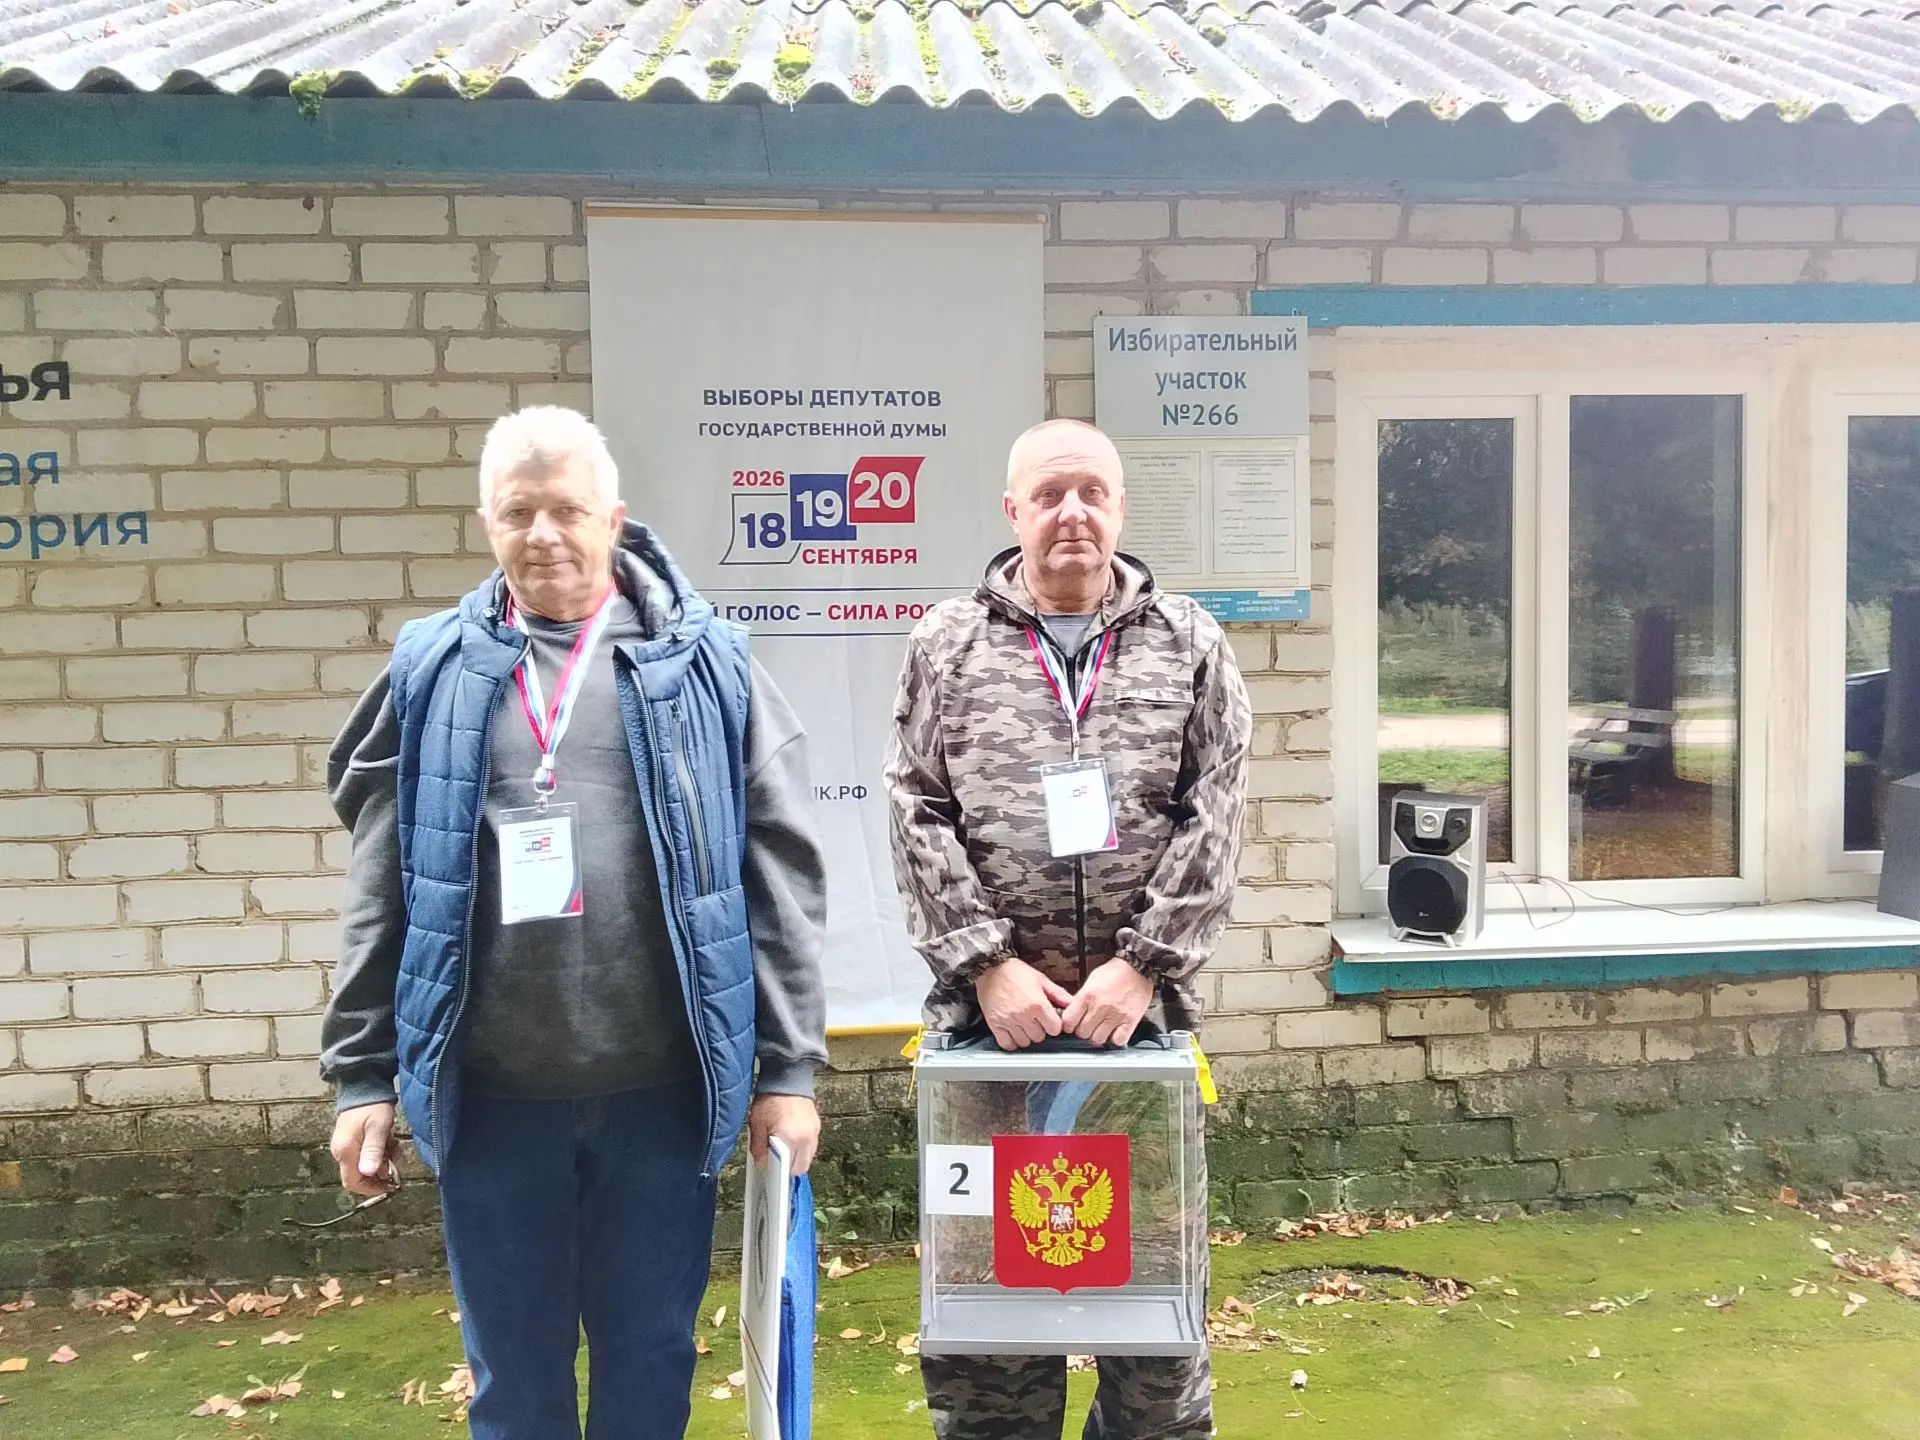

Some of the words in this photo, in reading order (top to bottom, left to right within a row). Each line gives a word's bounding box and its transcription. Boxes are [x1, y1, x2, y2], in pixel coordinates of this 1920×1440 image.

[1108, 328, 1298, 357] Избирательный
[1155, 371, 1247, 396] участок
[703, 389, 803, 406] ВЫБОРЫ
[809, 390, 942, 408] ДЕПУТАТОВ
[1162, 404, 1239, 426] №266
[699, 420, 885, 438] ГОСУДАРСТВЕННОЙ
[890, 423, 947, 438] ДУМЫ
[732, 470, 785, 487] 2026
[740, 512, 786, 548] 18
[796, 490, 843, 527] 19
[854, 471, 911, 508] 20
[802, 548, 917, 564] СЕНТЯБРЯ
[726, 605, 800, 621] ГОЛОС
[828, 604, 888, 621] СИЛА
[815, 785, 867, 800] К.РФ
[948, 1162, 971, 1196] 2
